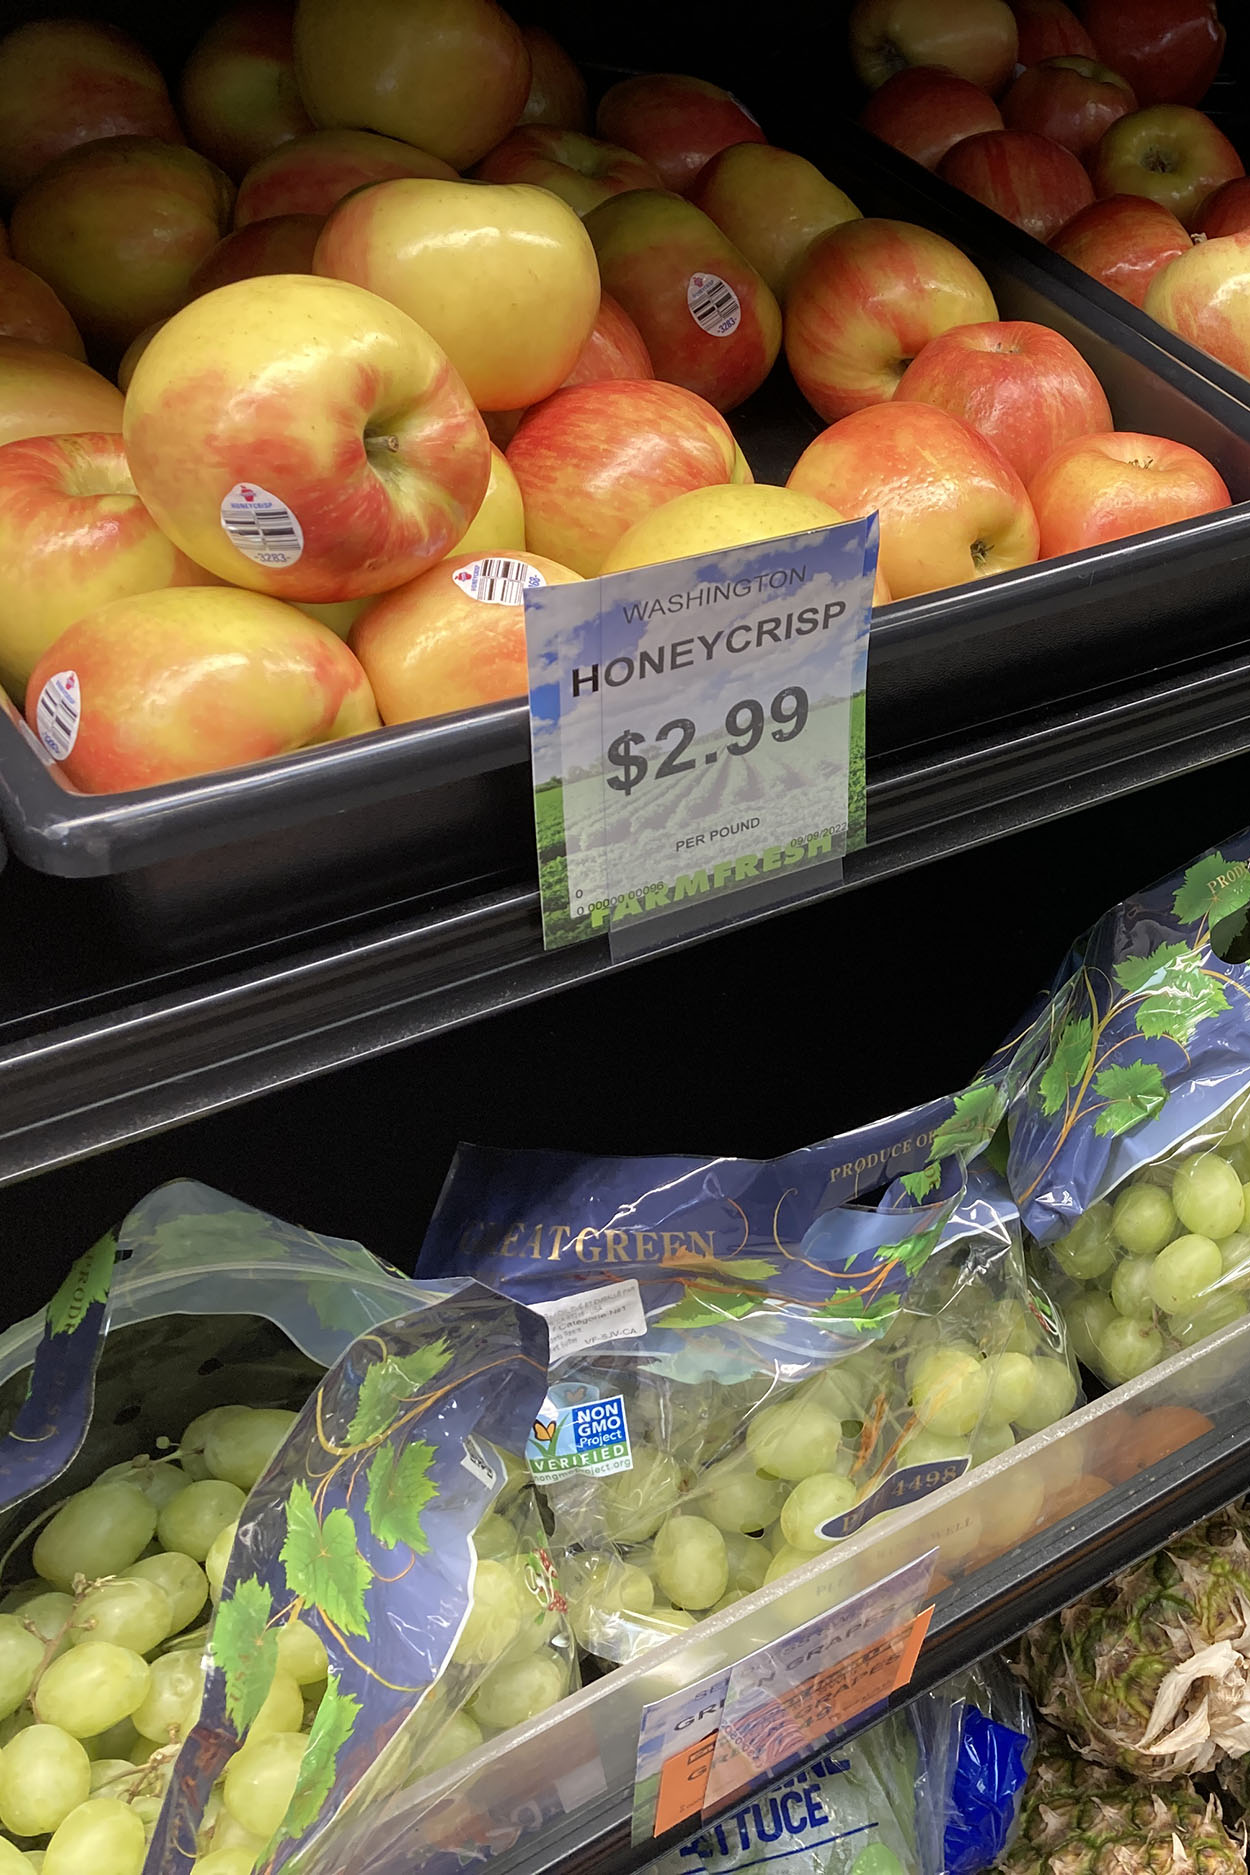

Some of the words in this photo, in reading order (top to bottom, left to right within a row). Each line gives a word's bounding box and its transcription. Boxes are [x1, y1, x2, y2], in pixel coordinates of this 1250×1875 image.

[622, 565, 808, 626] WASHINGTON
[572, 600, 847, 699] HONEYCRISP
[606, 685, 809, 796] $2.99
[676, 834, 705, 852] PER
[709, 816, 761, 842] POUND
[790, 821, 848, 848] 09/09/2022
[575, 889, 584, 899] 0
[590, 834, 833, 929] FARMFRESH
[575, 905, 585, 916] 0
[830, 1139, 913, 1183] PRODUCE
[575, 1227, 717, 1264] GREEN
[584, 1327, 638, 1345] VF-SJV-CA
[577, 1402, 619, 1423] NON
[577, 1416, 621, 1437] GMO
[579, 1430, 622, 1447] Project
[535, 1444, 625, 1471] VERIFIED
[891, 1466, 957, 1497] 4498
